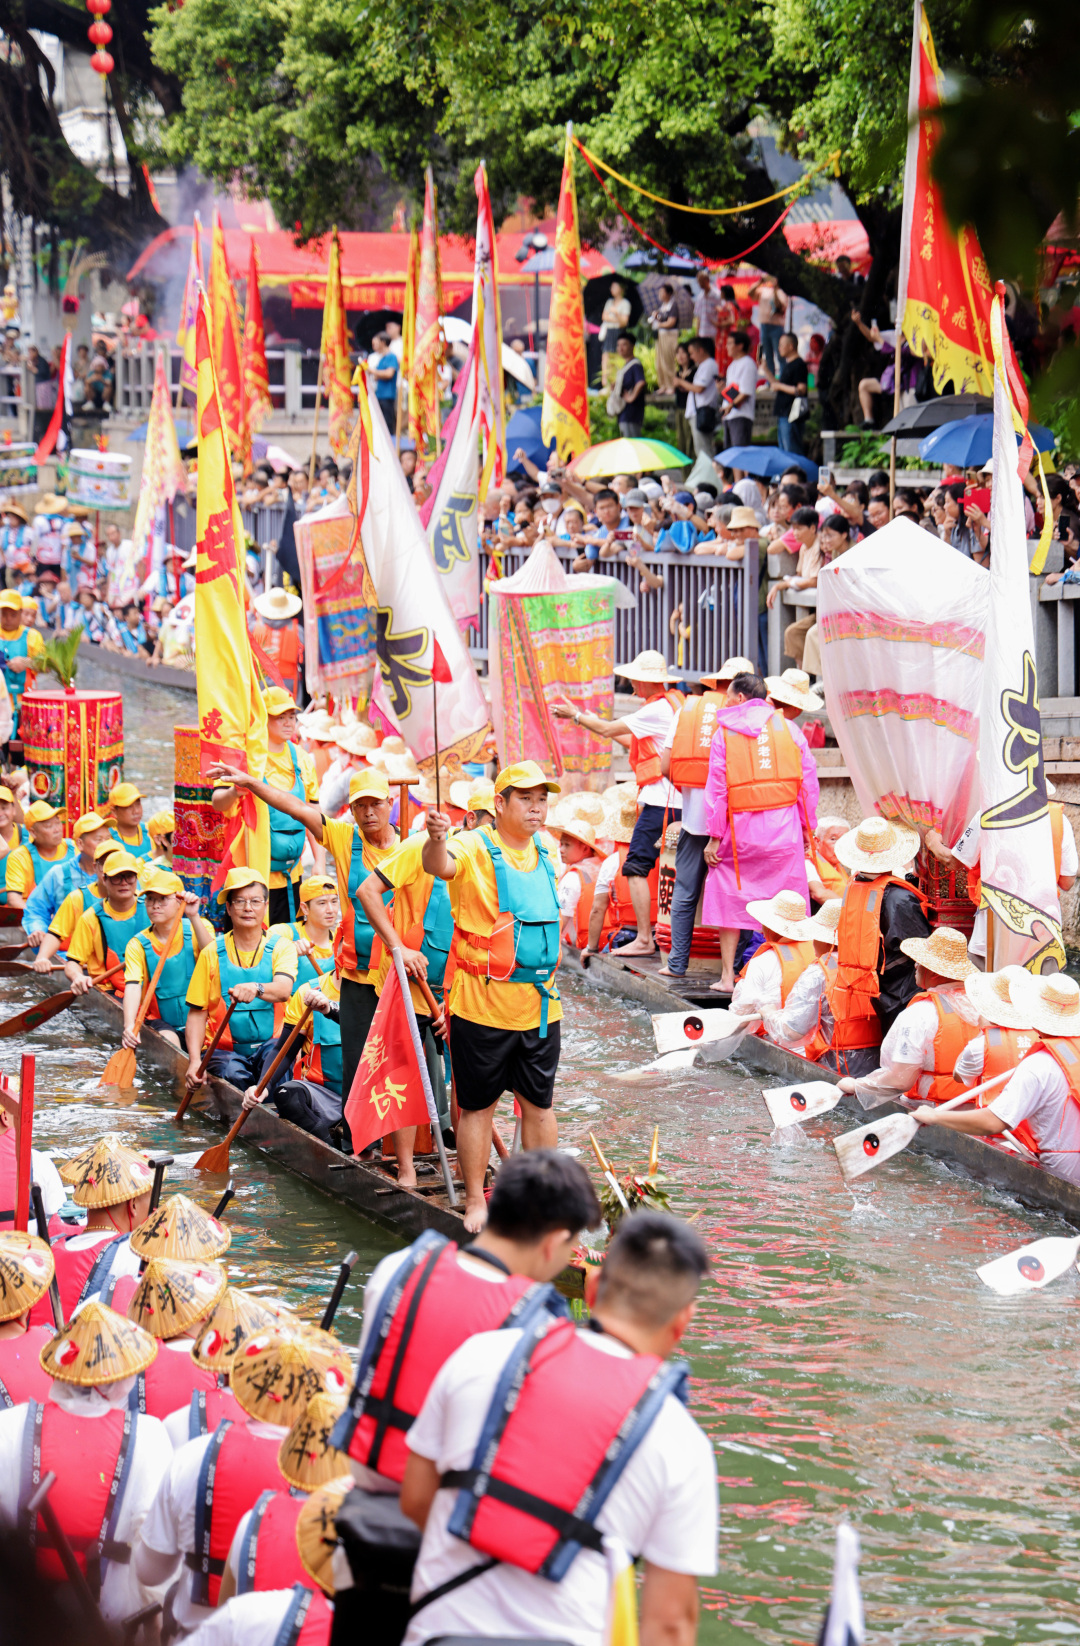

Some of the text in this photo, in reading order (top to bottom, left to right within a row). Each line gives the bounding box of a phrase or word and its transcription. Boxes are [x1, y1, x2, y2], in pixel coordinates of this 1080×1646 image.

[699, 702, 718, 748] 盐步老龙
[81, 1280, 90, 1298] JUST
[137, 1377, 146, 1412] JUST GO
[32, 1444, 41, 1484] JUST GO
[110, 1455, 124, 1495] JUST GO
